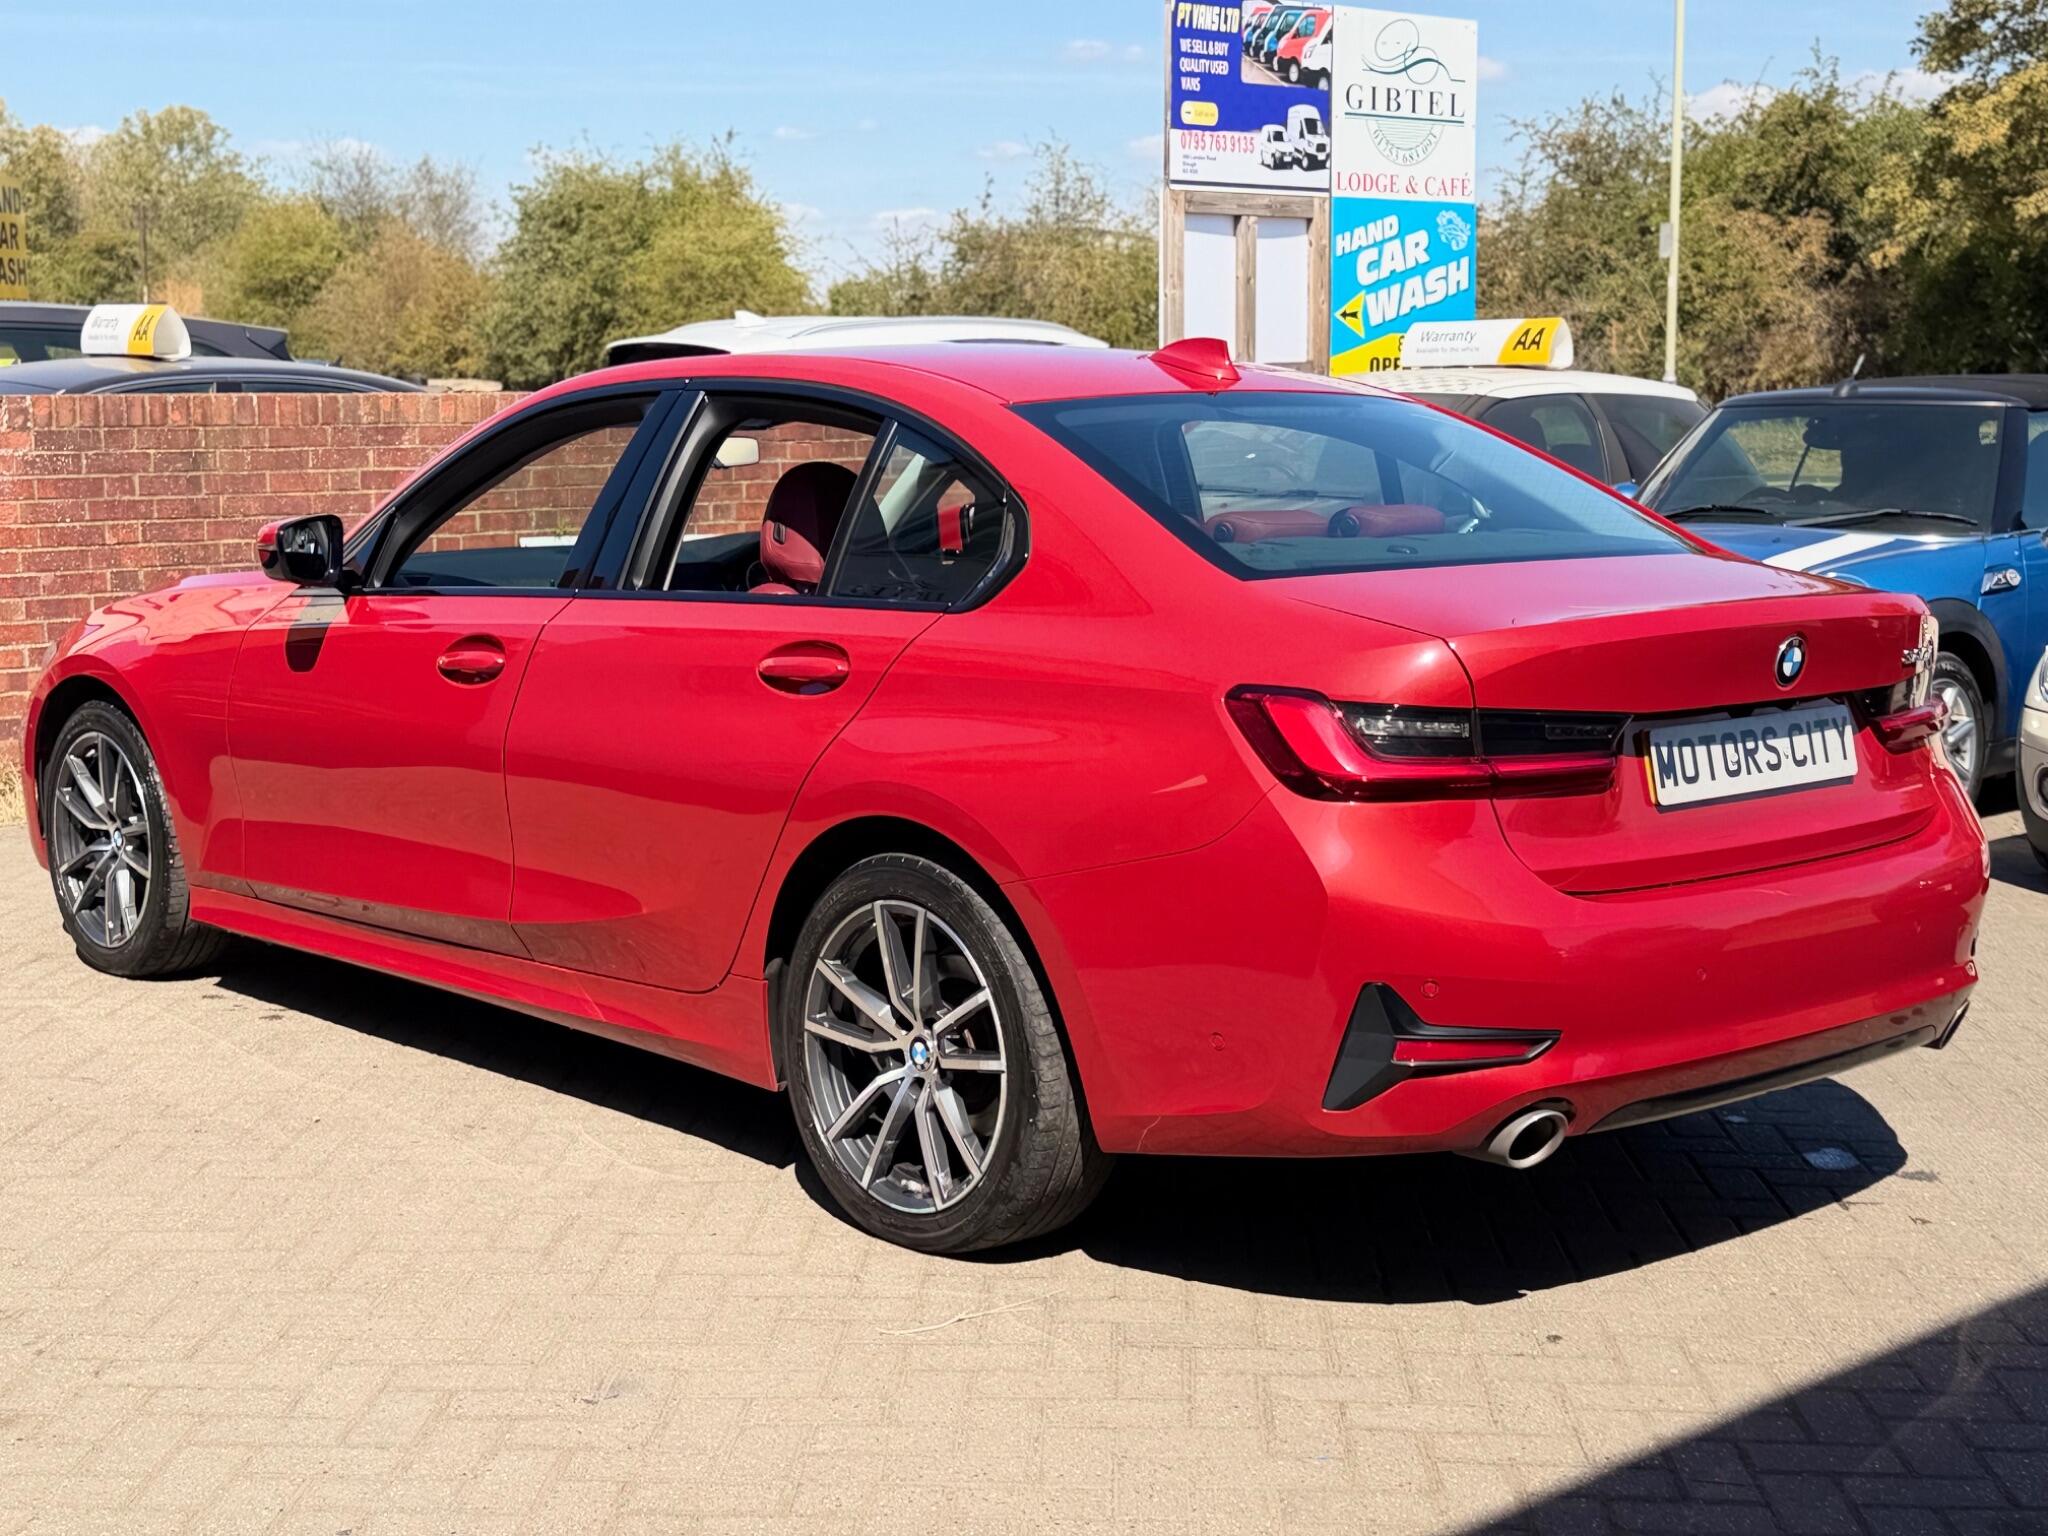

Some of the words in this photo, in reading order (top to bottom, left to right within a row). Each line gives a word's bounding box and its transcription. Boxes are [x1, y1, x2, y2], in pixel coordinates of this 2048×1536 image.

[1177, 3, 1192, 28] PT
[1193, 4, 1220, 31] VANS
[1220, 7, 1240, 33] LTD
[1180, 38, 1191, 53] WE
[1192, 39, 1208, 55] SELL
[1208, 41, 1214, 55] &
[1214, 41, 1229, 56] BUY
[1180, 57, 1210, 73] QUALITY
[1210, 60, 1229, 75] USED
[1180, 76, 1201, 92] VANS
[1346, 83, 1465, 118] GIBTEL
[1181, 131, 1206, 151] 0795
[1209, 134, 1227, 152] 763
[1230, 135, 1255, 154] 9135
[1337, 171, 1400, 194] LODGE
[1405, 175, 1418, 194] &
[1424, 171, 1473, 197] CAFÉ
[0, 186, 21, 215] ND
[1335, 214, 1399, 257] HAND
[1356, 229, 1431, 286] CAR
[1365, 256, 1470, 327] WASH
[133, 315, 154, 341] AA
[1420, 330, 1478, 343] Warranty
[1512, 327, 1546, 351] AA
[1654, 726, 1782, 789] MOTORS
[1788, 716, 1848, 768] CITY
